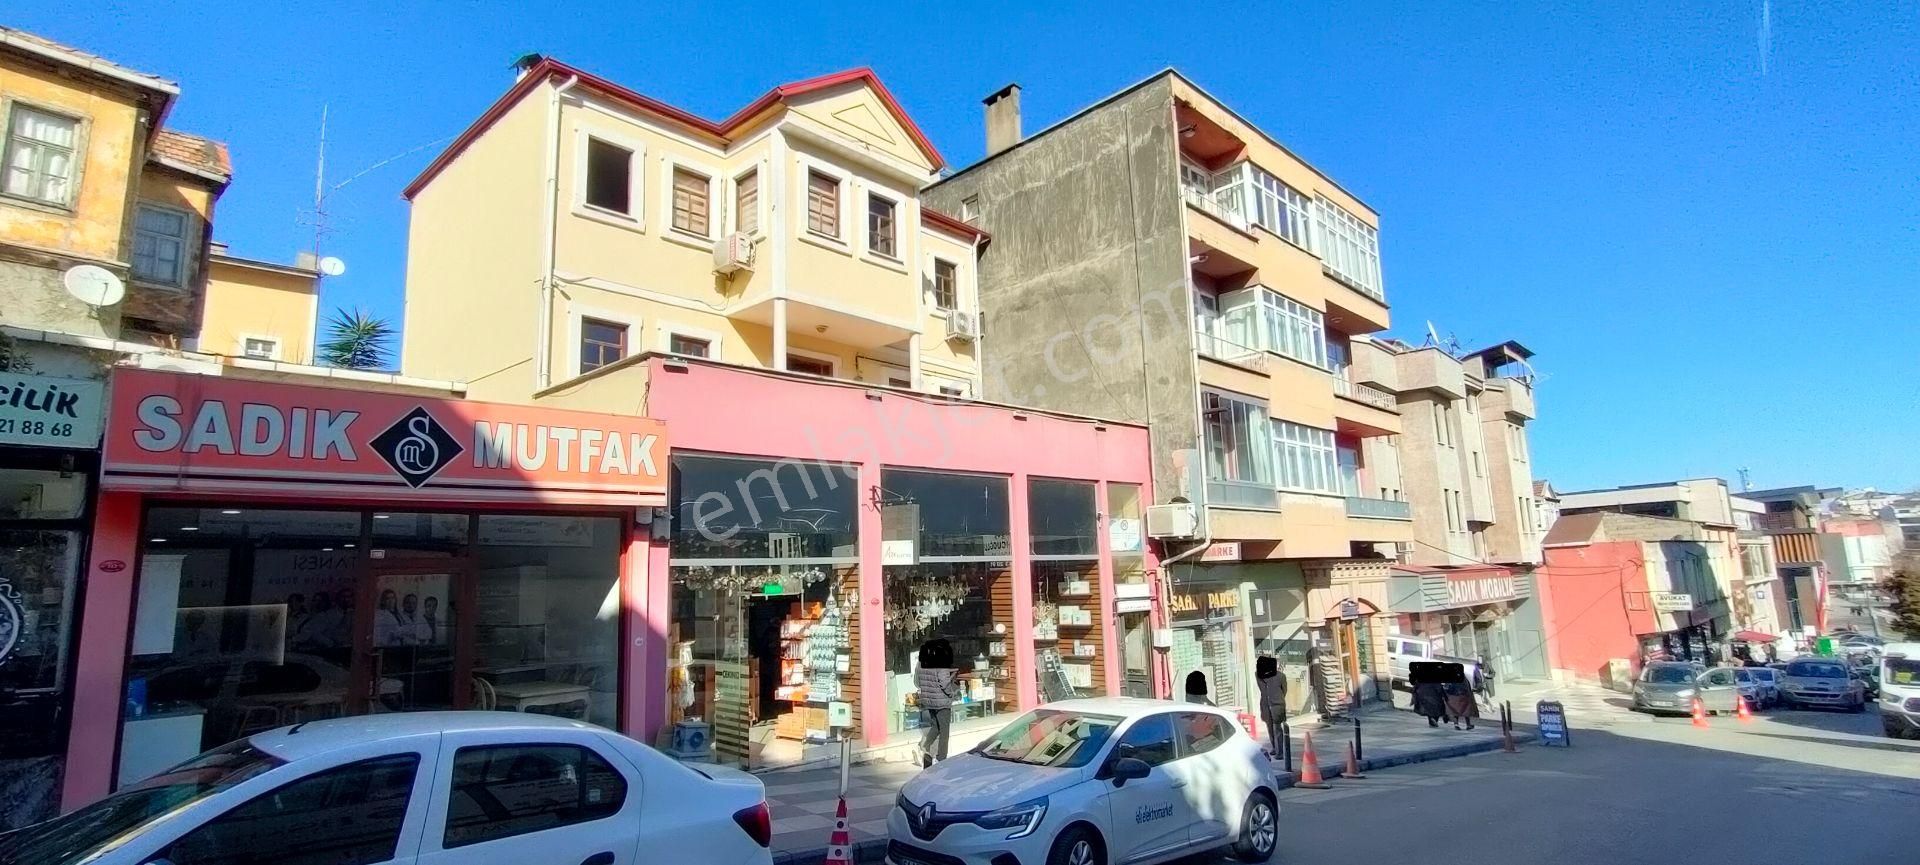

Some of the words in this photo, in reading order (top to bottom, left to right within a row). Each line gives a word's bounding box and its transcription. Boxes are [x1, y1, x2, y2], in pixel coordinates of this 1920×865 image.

[21, 420, 44, 435] 88
[51, 422, 72, 437] 68
[132, 394, 361, 461] SADIK
[473, 420, 658, 477] MUTFAK
[1448, 580, 1478, 604] SADIK
